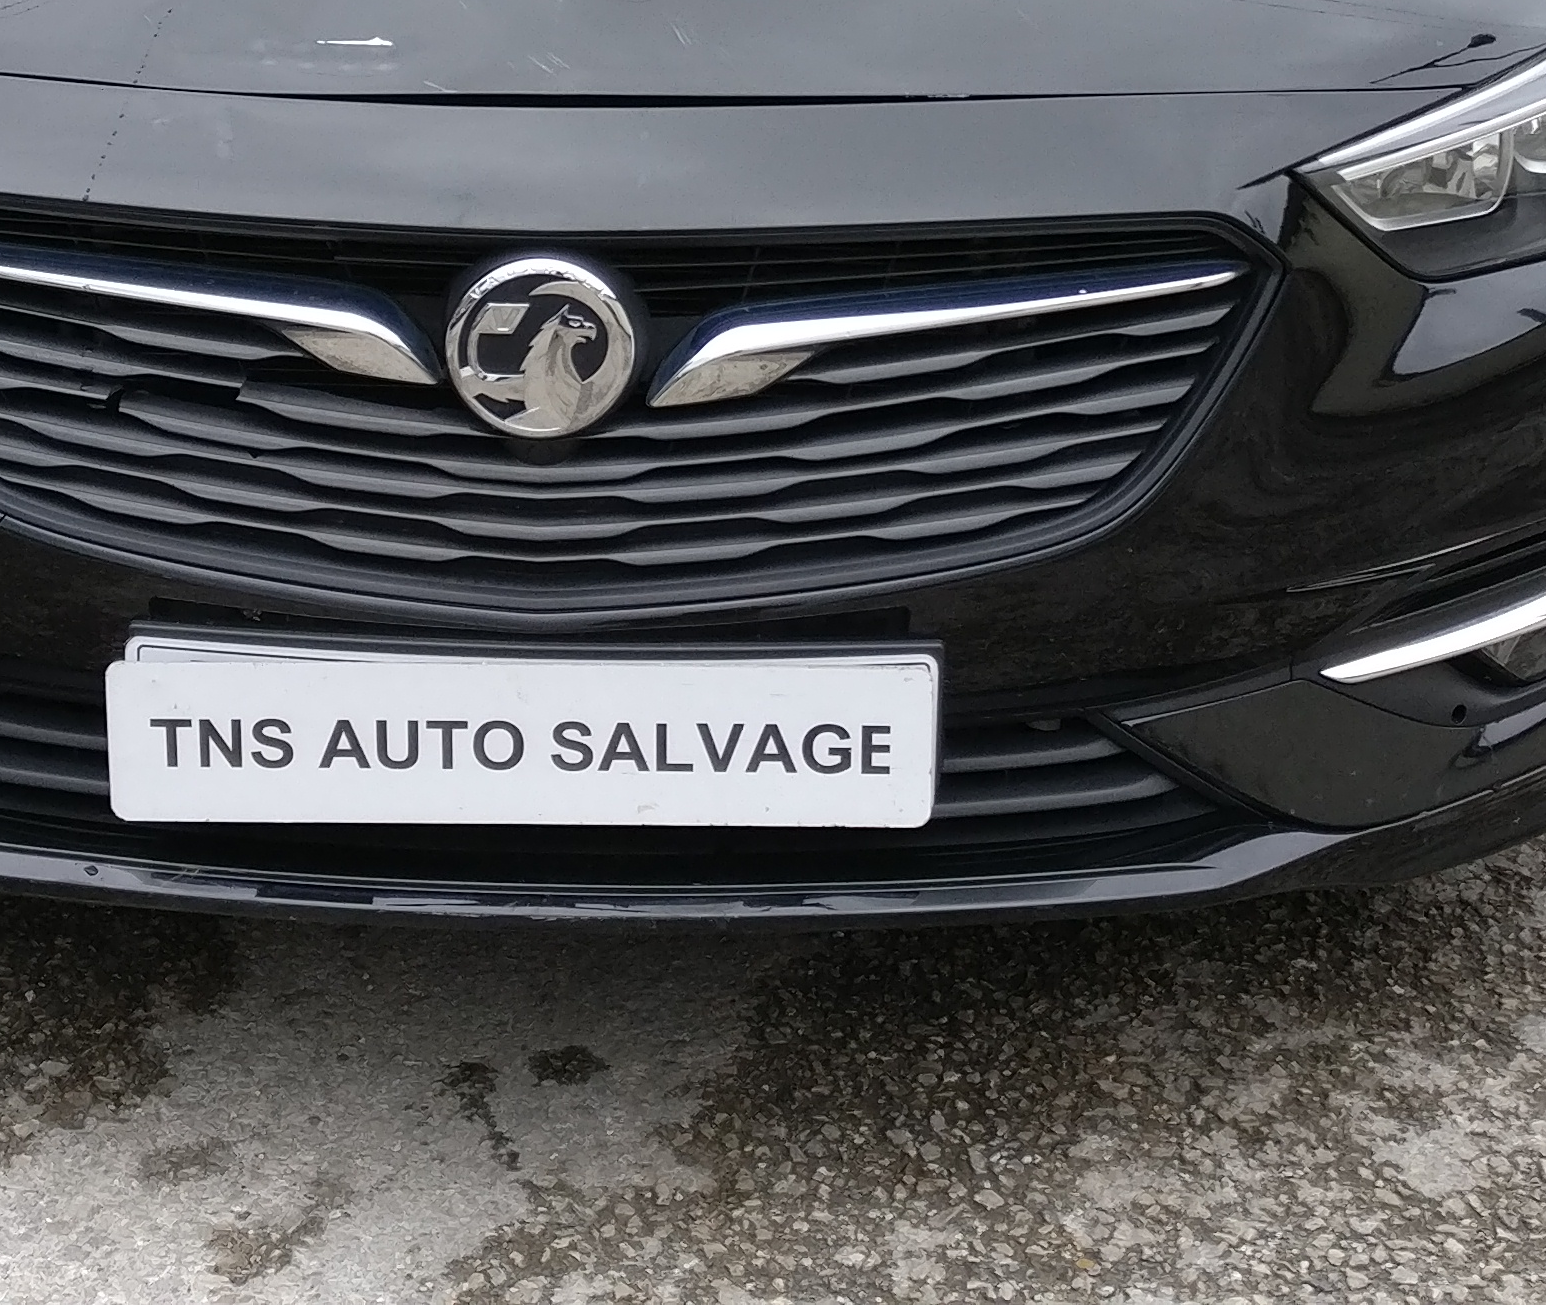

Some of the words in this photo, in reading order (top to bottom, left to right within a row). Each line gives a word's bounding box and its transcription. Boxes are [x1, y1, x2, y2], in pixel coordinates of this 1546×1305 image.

[149, 717, 294, 770] TNS
[318, 718, 526, 772] AUTO
[550, 721, 892, 776] SALVAGE
